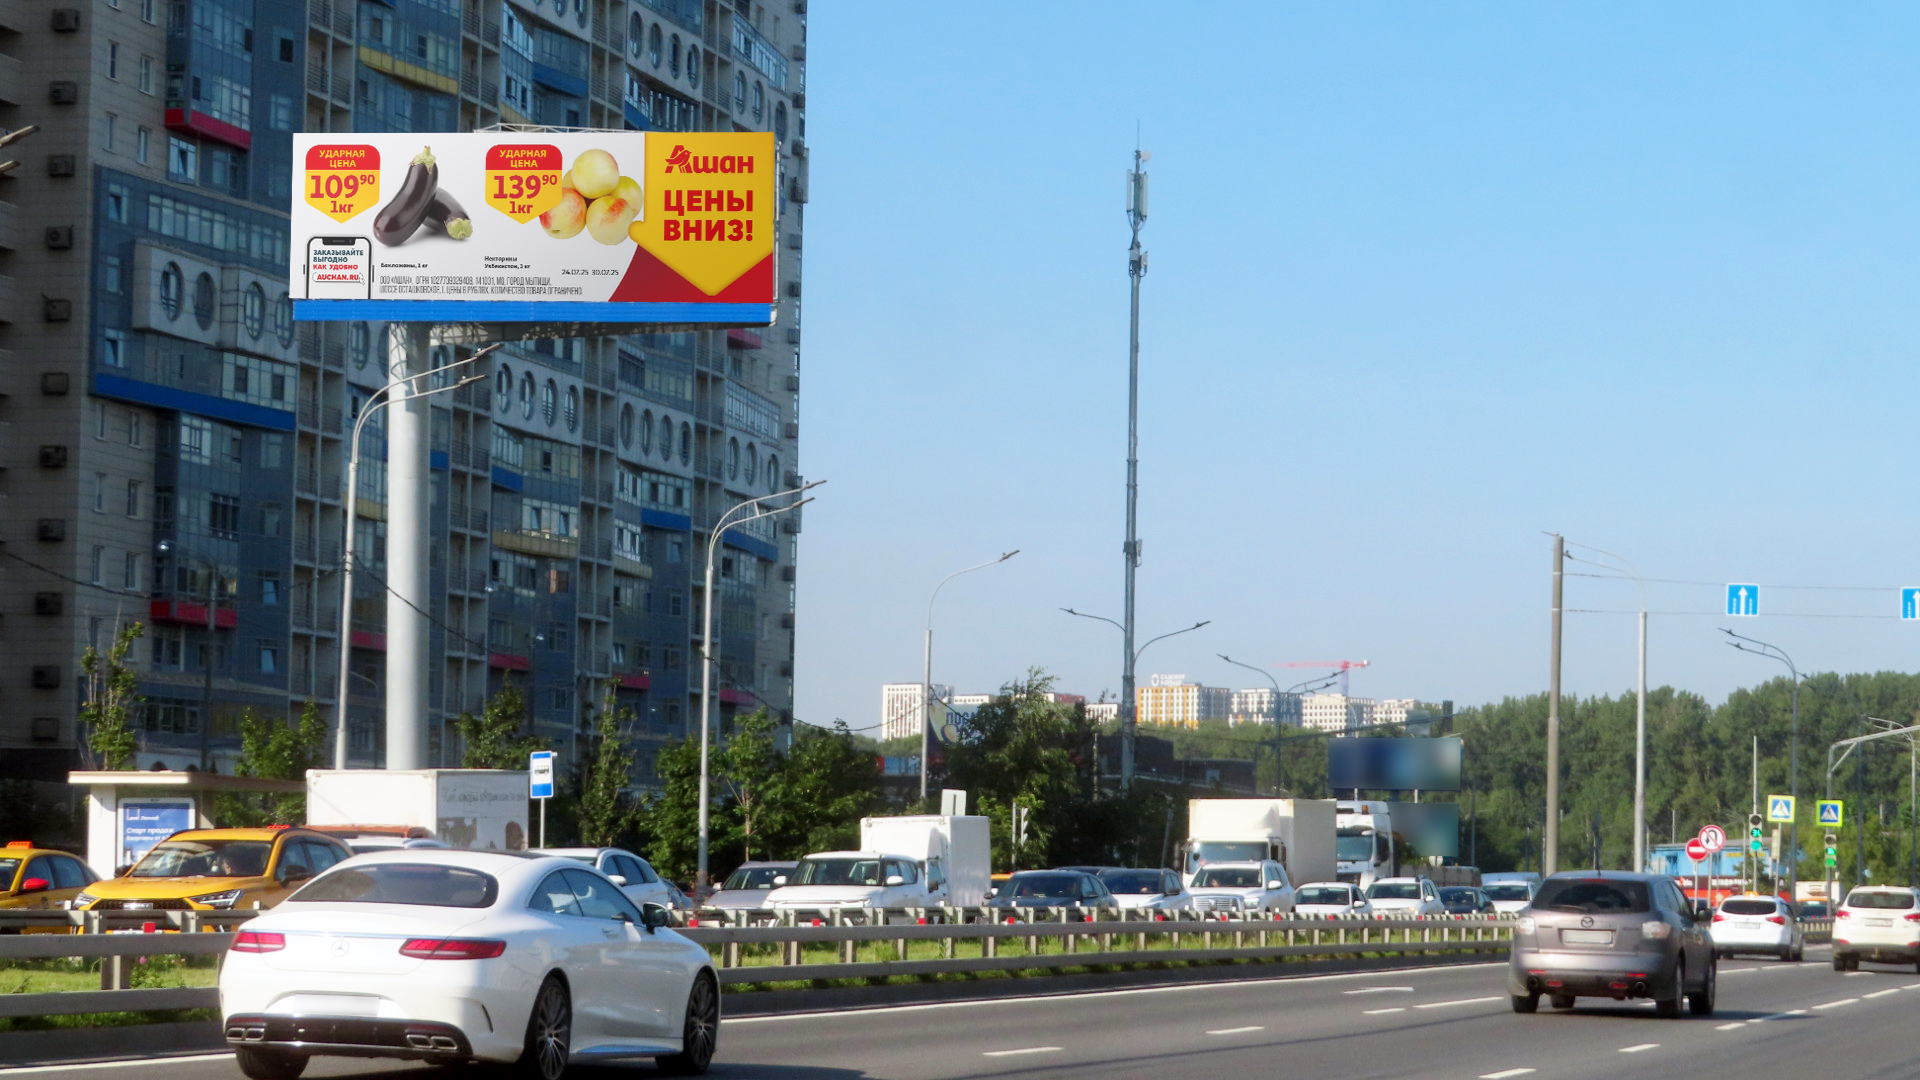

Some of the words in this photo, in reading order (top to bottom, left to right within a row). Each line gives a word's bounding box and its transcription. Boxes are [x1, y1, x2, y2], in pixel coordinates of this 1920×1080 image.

[319, 150, 365, 158] УДАРНАЯ
[500, 150, 546, 158] УДАРНАЯ
[664, 144, 754, 173] Ашан
[330, 160, 356, 168] ЦЕНА
[510, 160, 538, 168] ЦЕНА
[330, 200, 354, 213] 1кг
[509, 201, 533, 214] 1кг
[664, 190, 753, 216] ЦЕНЫ
[664, 219, 753, 241] ВНИЗ!
